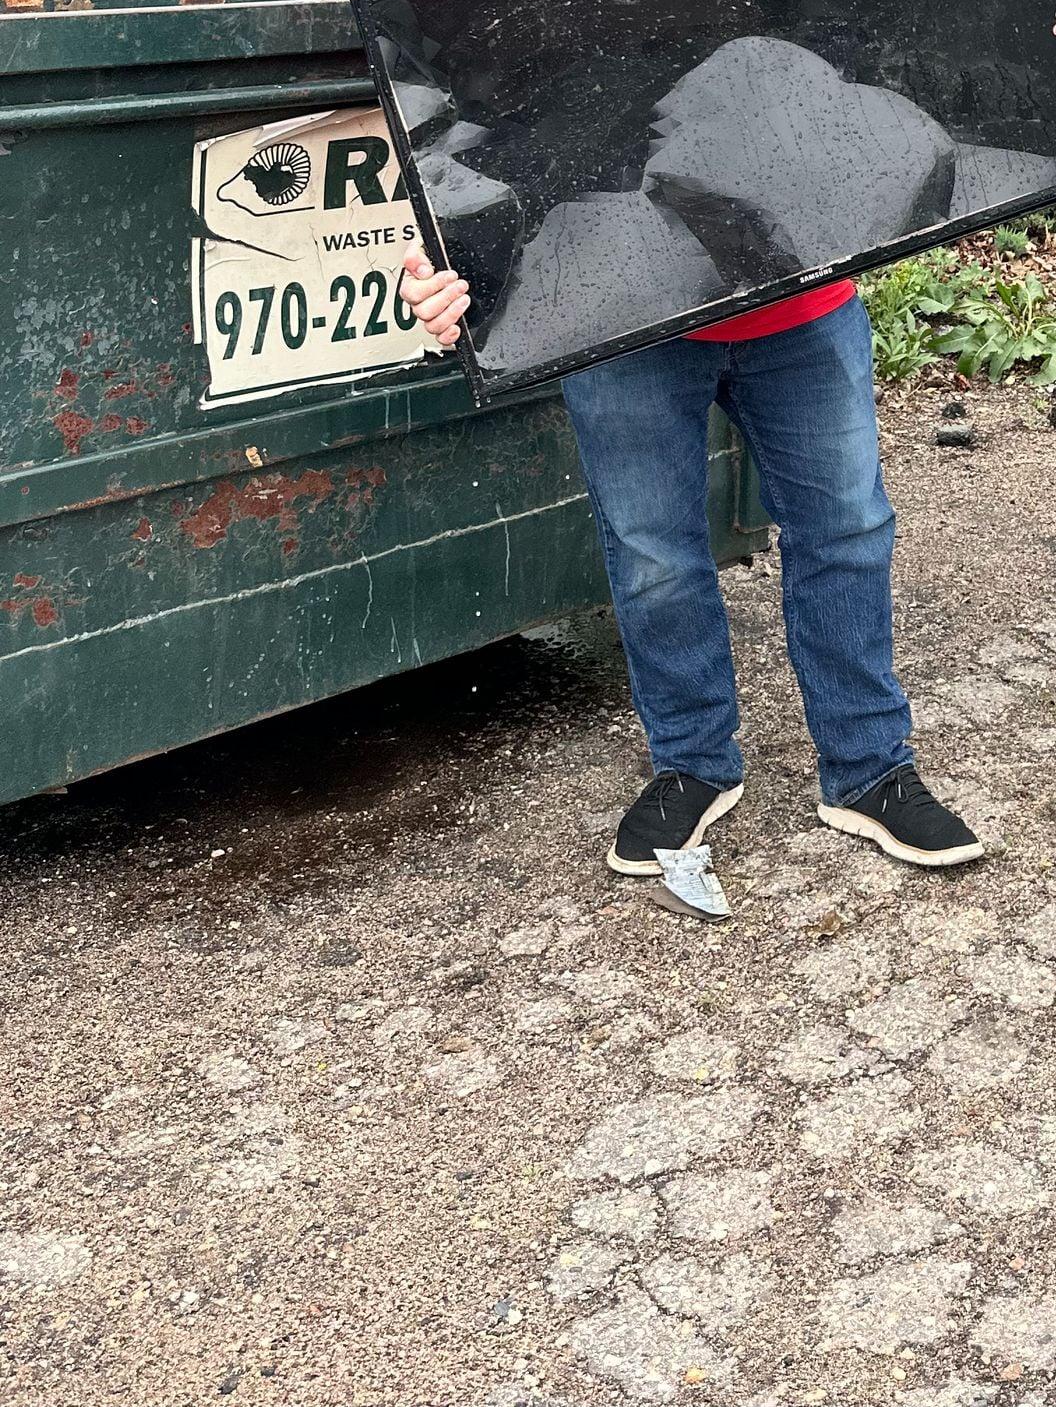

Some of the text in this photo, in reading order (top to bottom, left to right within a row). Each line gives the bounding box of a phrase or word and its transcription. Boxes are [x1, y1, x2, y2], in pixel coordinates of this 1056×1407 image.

[323, 224, 414, 252] WASTE S
[799, 267, 833, 283] SAMSUNG
